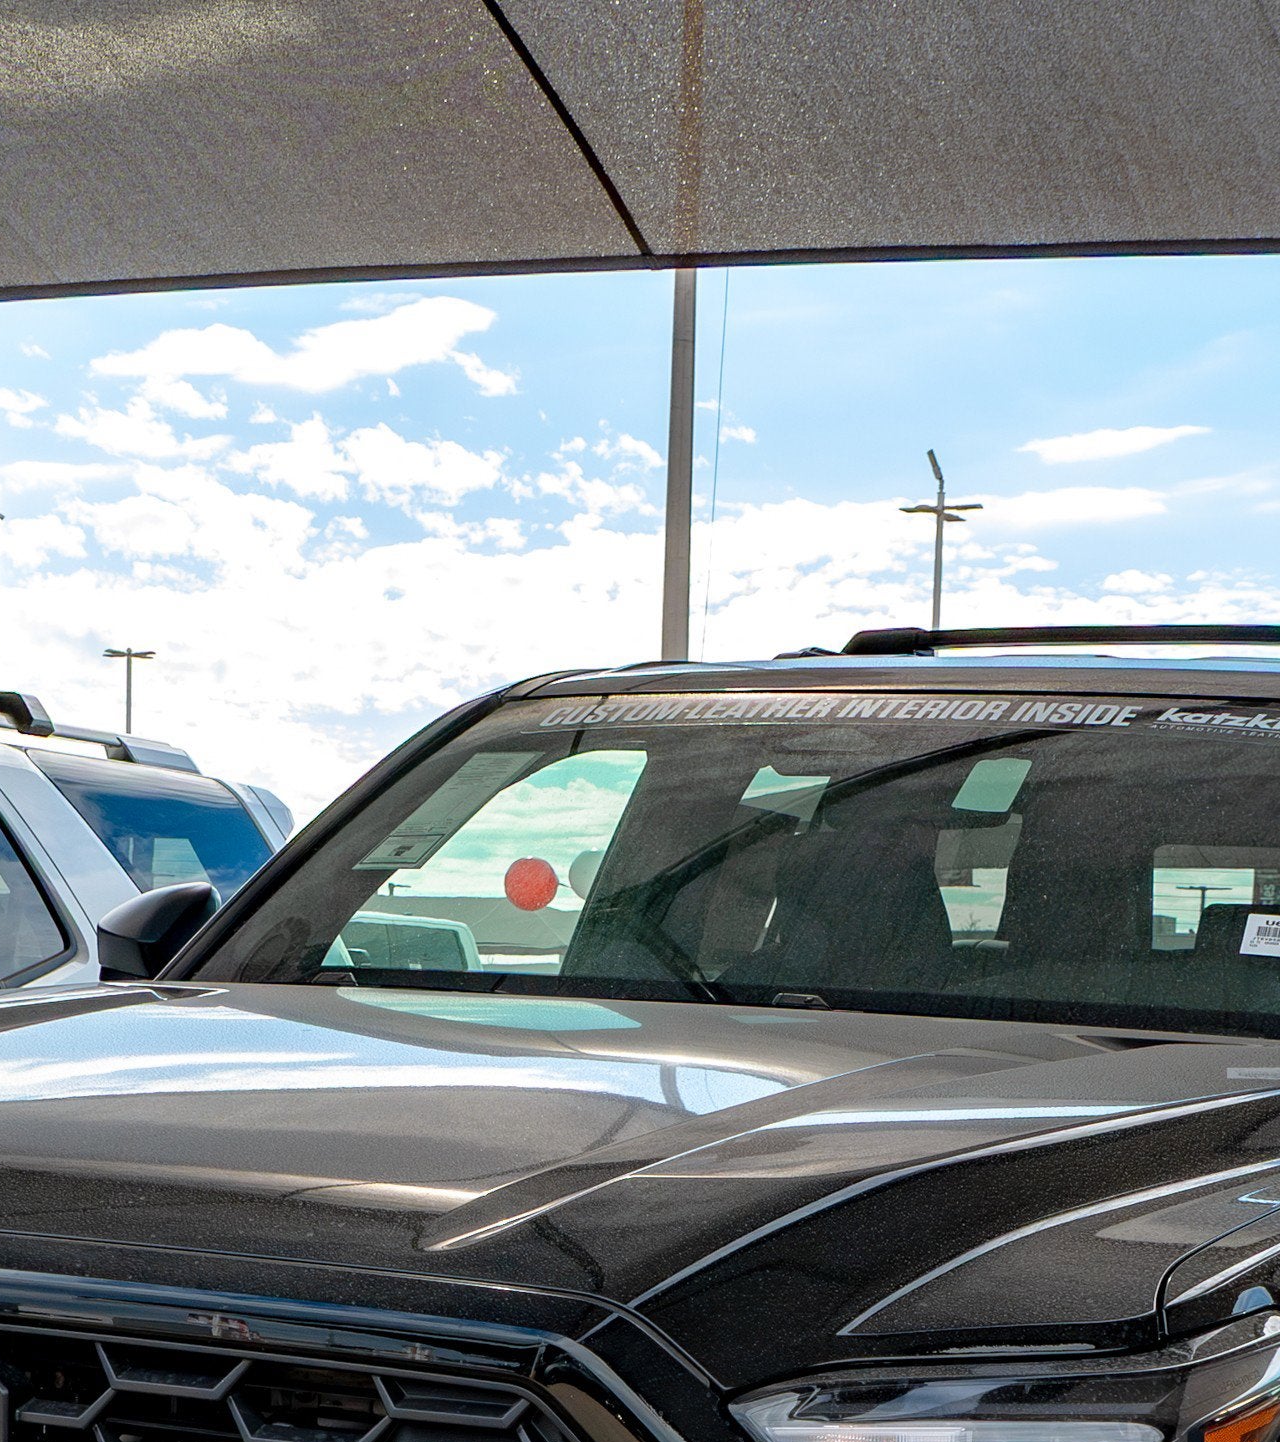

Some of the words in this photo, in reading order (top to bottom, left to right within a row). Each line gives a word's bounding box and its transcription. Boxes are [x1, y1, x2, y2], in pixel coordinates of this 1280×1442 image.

[540, 700, 686, 727] CUSTOM
[684, 699, 840, 720] LEATHER
[837, 699, 1011, 722] INTERIOR
[1007, 701, 1143, 728] INSIDE
[1151, 723, 1235, 736] AUTOMOTIVE
